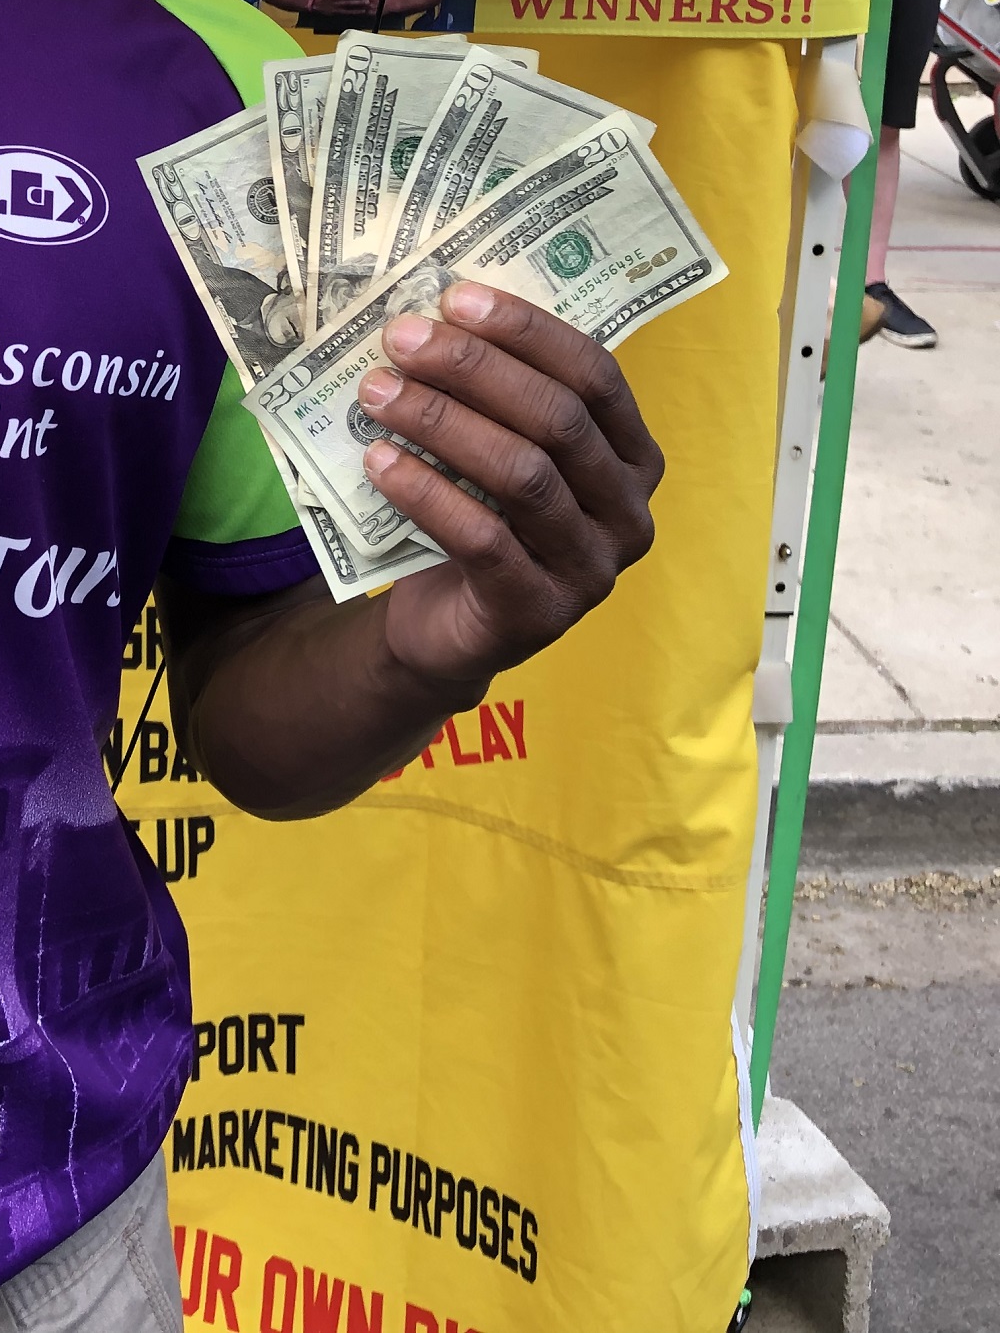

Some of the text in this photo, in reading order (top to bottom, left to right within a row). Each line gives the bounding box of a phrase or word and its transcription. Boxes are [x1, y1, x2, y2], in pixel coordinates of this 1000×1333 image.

[331, 122, 348, 161] NOTE
[425, 134, 448, 171] NOTE
[578, 127, 630, 169] 20
[151, 161, 202, 241] 20
[318, 171, 552, 359] FEDERAL RESERVE NOTE
[553, 300, 573, 317] MK
[571, 254, 635, 303] 45545649
[633, 247, 647, 261] E
[600, 263, 706, 339] DOLLARS
[257, 364, 315, 415] 20
[294, 348, 380, 422] MK 45545649 E
[307, 413, 335, 438] K11
[157, 816, 216, 884] UP
[172, 1108, 540, 1285] MARKETING PURPOSES
[174, 1224, 244, 1333] UR
